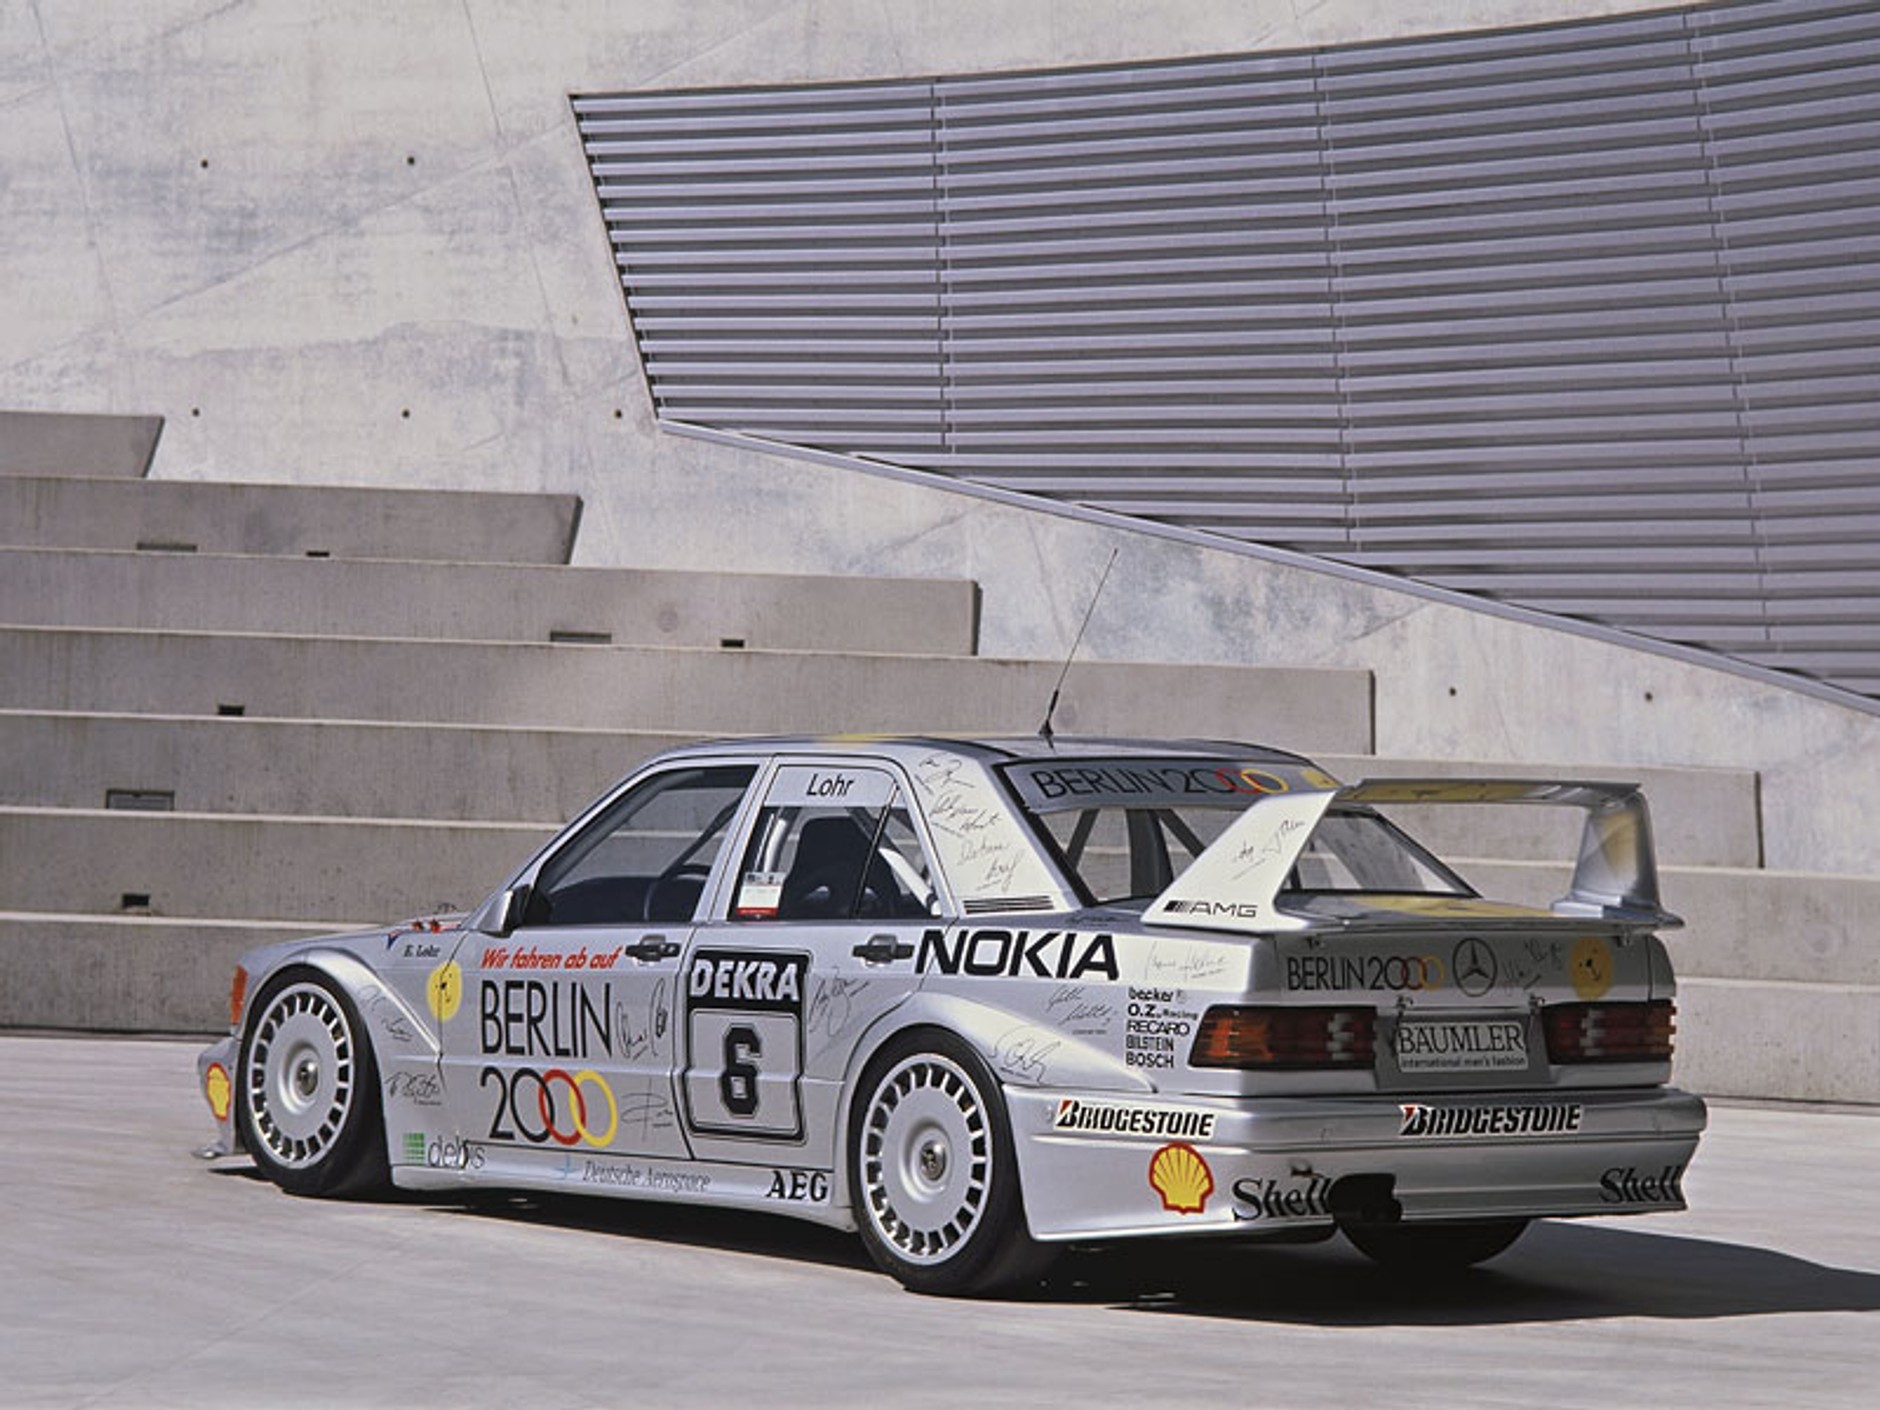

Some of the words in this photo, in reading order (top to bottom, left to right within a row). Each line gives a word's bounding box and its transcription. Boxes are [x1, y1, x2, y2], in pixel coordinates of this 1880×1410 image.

[806, 773, 854, 797] Lohr
[1031, 768, 1171, 799] BERLIN
[1171, 767, 1289, 795] 2000
[1188, 901, 1258, 918] AMG
[480, 947, 510, 968] Wir
[510, 946, 562, 968] fahren
[564, 949, 587, 968] ab
[589, 946, 623, 968] auf
[915, 928, 1120, 980] NOKIA
[690, 958, 800, 1001] DEKRA
[1287, 956, 1365, 991] BERLIN
[1368, 955, 1445, 992] 2000
[1128, 986, 1174, 1002] becker
[480, 979, 613, 1059] BERLIN
[1126, 1019, 1191, 1037] RECARO
[1126, 1034, 1174, 1051] BILSTEIN
[1399, 1024, 1524, 1054] BÄUMLER
[720, 1023, 762, 1118] 6
[1126, 1051, 1174, 1068] BOSCH
[1401, 1056, 1462, 1069] international
[1464, 1056, 1491, 1067] men's
[1492, 1055, 1526, 1067] fashion
[480, 1065, 618, 1149] 2000
[1056, 1099, 1214, 1137] BRIDGESTONE
[1400, 1104, 1580, 1136] BRIDGESTONE
[583, 1160, 642, 1187] Deutsche
[644, 1166, 712, 1193] Aerospace
[765, 1169, 829, 1202] AEG
[1599, 1165, 1684, 1204] Shell
[1231, 1177, 1335, 1222] Shell
